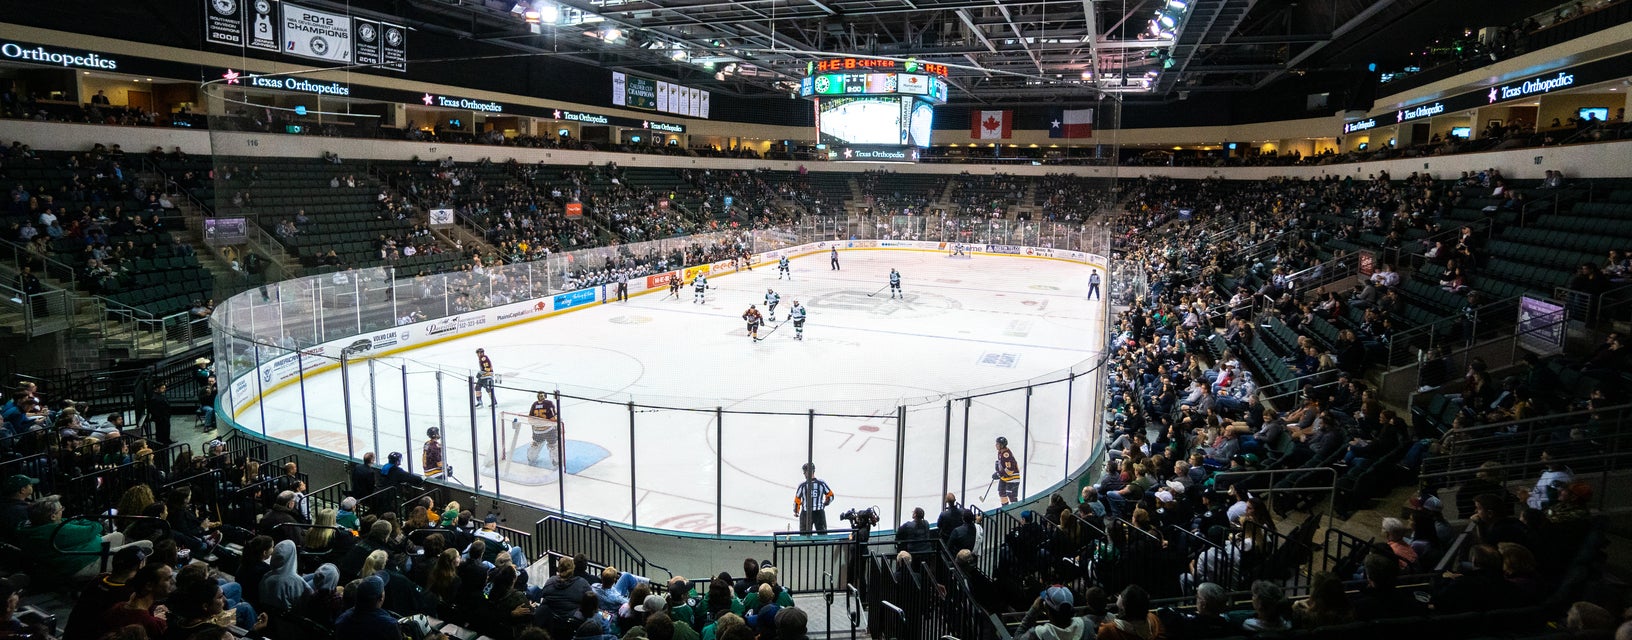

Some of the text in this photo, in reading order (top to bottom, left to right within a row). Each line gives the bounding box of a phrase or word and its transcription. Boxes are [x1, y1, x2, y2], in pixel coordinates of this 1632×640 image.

[303, 13, 334, 26] 2012
[259, 22, 268, 33] 3
[287, 21, 349, 39] CHAMPIONS
[212, 32, 240, 42] 2008
[1, 43, 117, 70] Orthopedics
[249, 74, 349, 95] Texas Orthopedics
[1501, 72, 1574, 99] Texas Orthopedics
[627, 88, 655, 98] CHAMPIONS
[439, 96, 502, 112] Texas Orthopedics
[563, 111, 608, 124] Texas Orthopedics
[1404, 102, 1444, 120] Texas Orthopedics
[247, 139, 259, 147] 116
[855, 150, 905, 159] Texas Orthopedics
